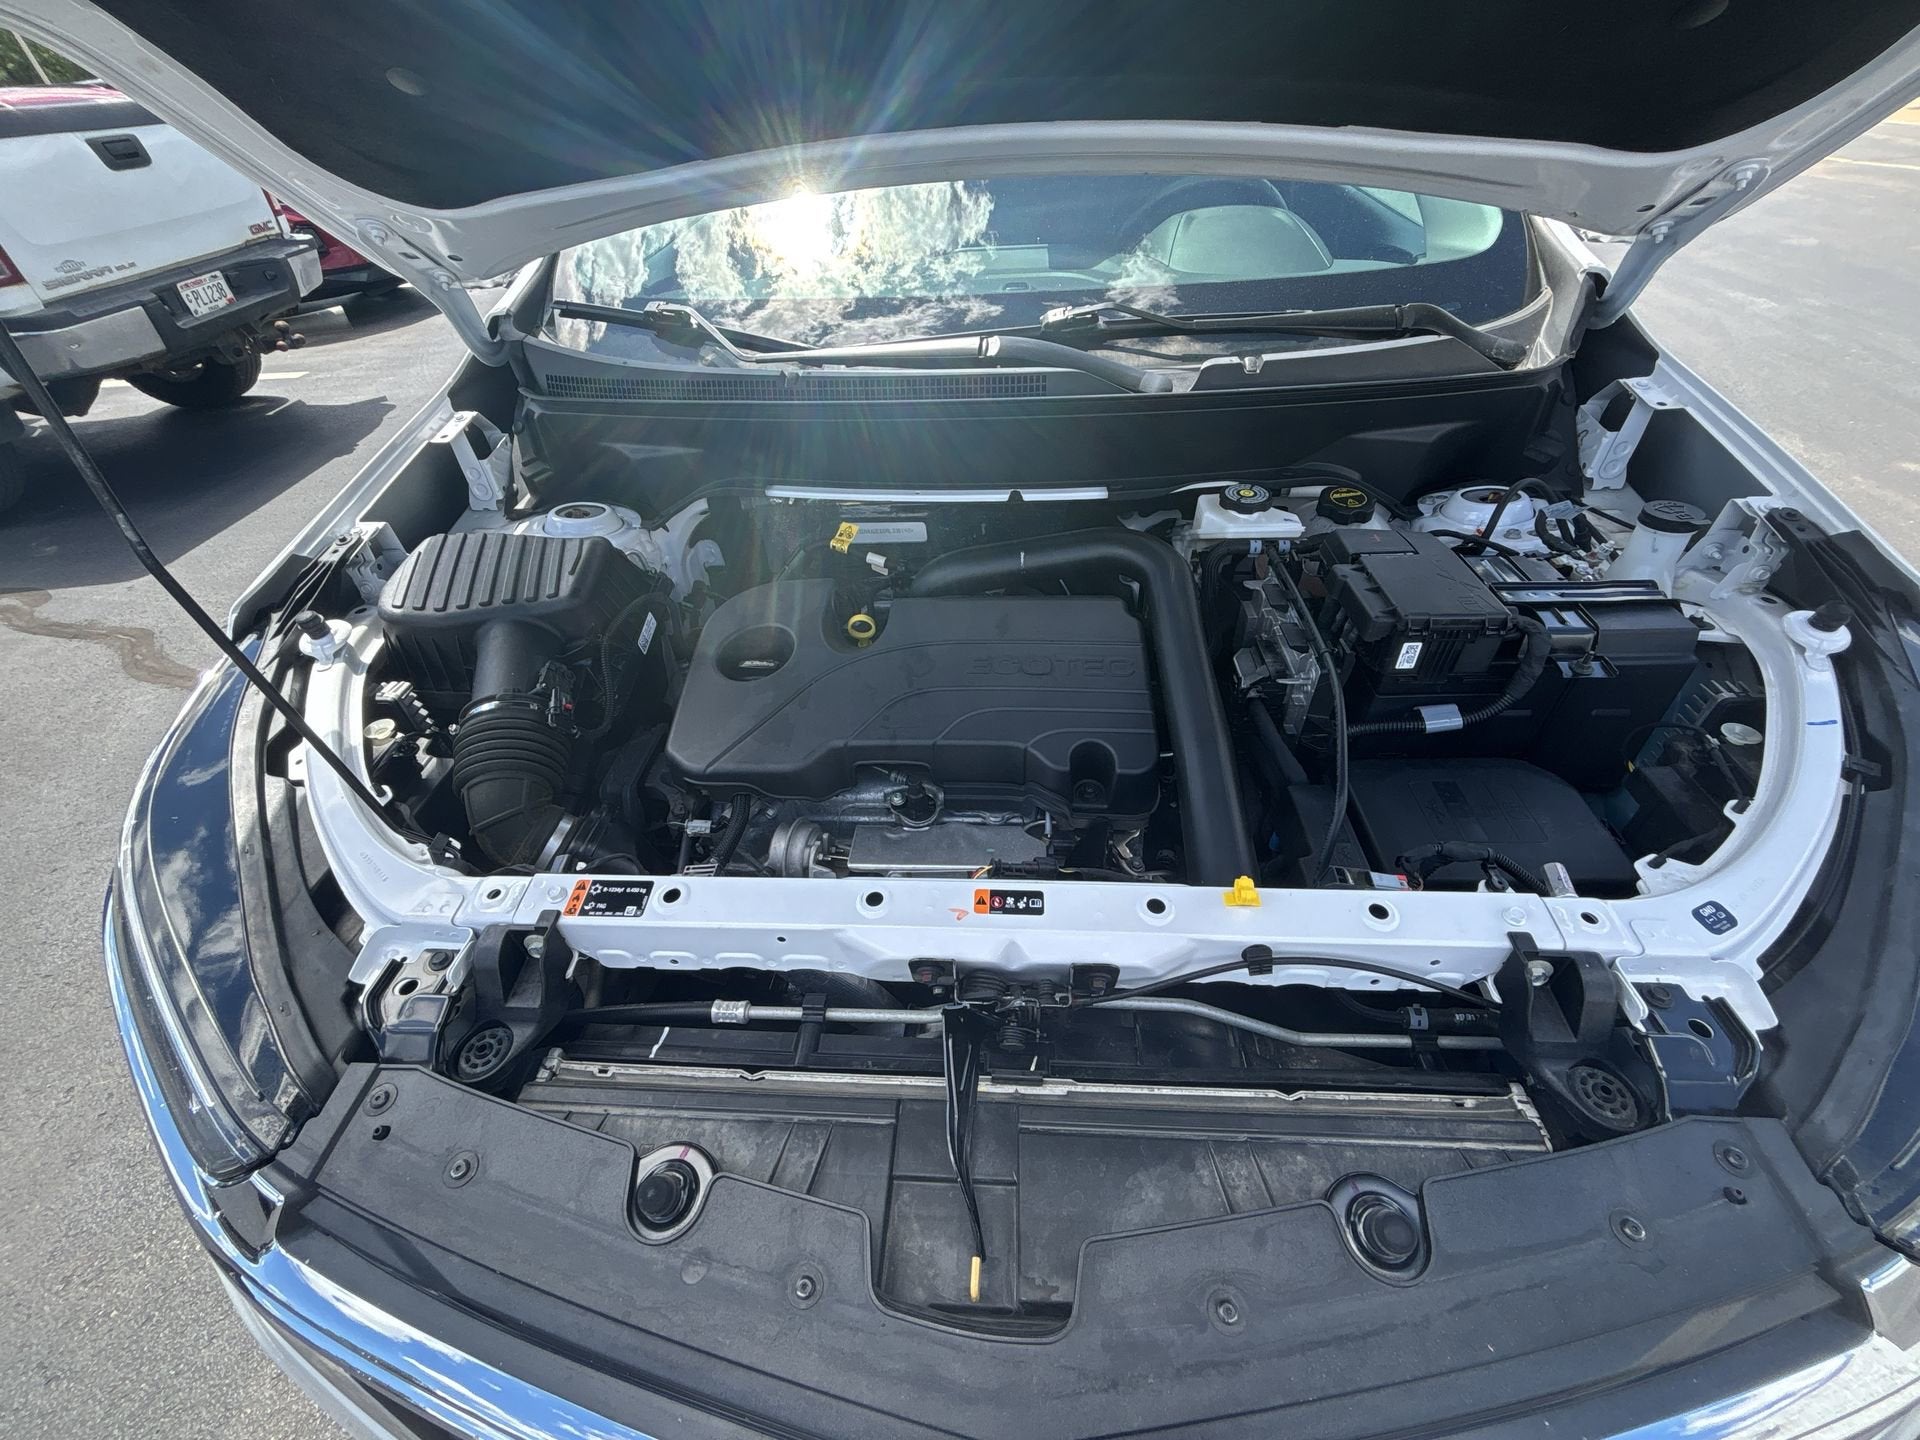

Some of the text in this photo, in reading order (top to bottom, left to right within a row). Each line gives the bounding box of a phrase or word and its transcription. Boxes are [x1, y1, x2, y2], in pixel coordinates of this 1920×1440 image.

[248, 220, 275, 235] GMC
[42, 265, 114, 290] SIERRA
[966, 656, 1137, 679] ECOTEC
[1699, 904, 1716, 917] GND
